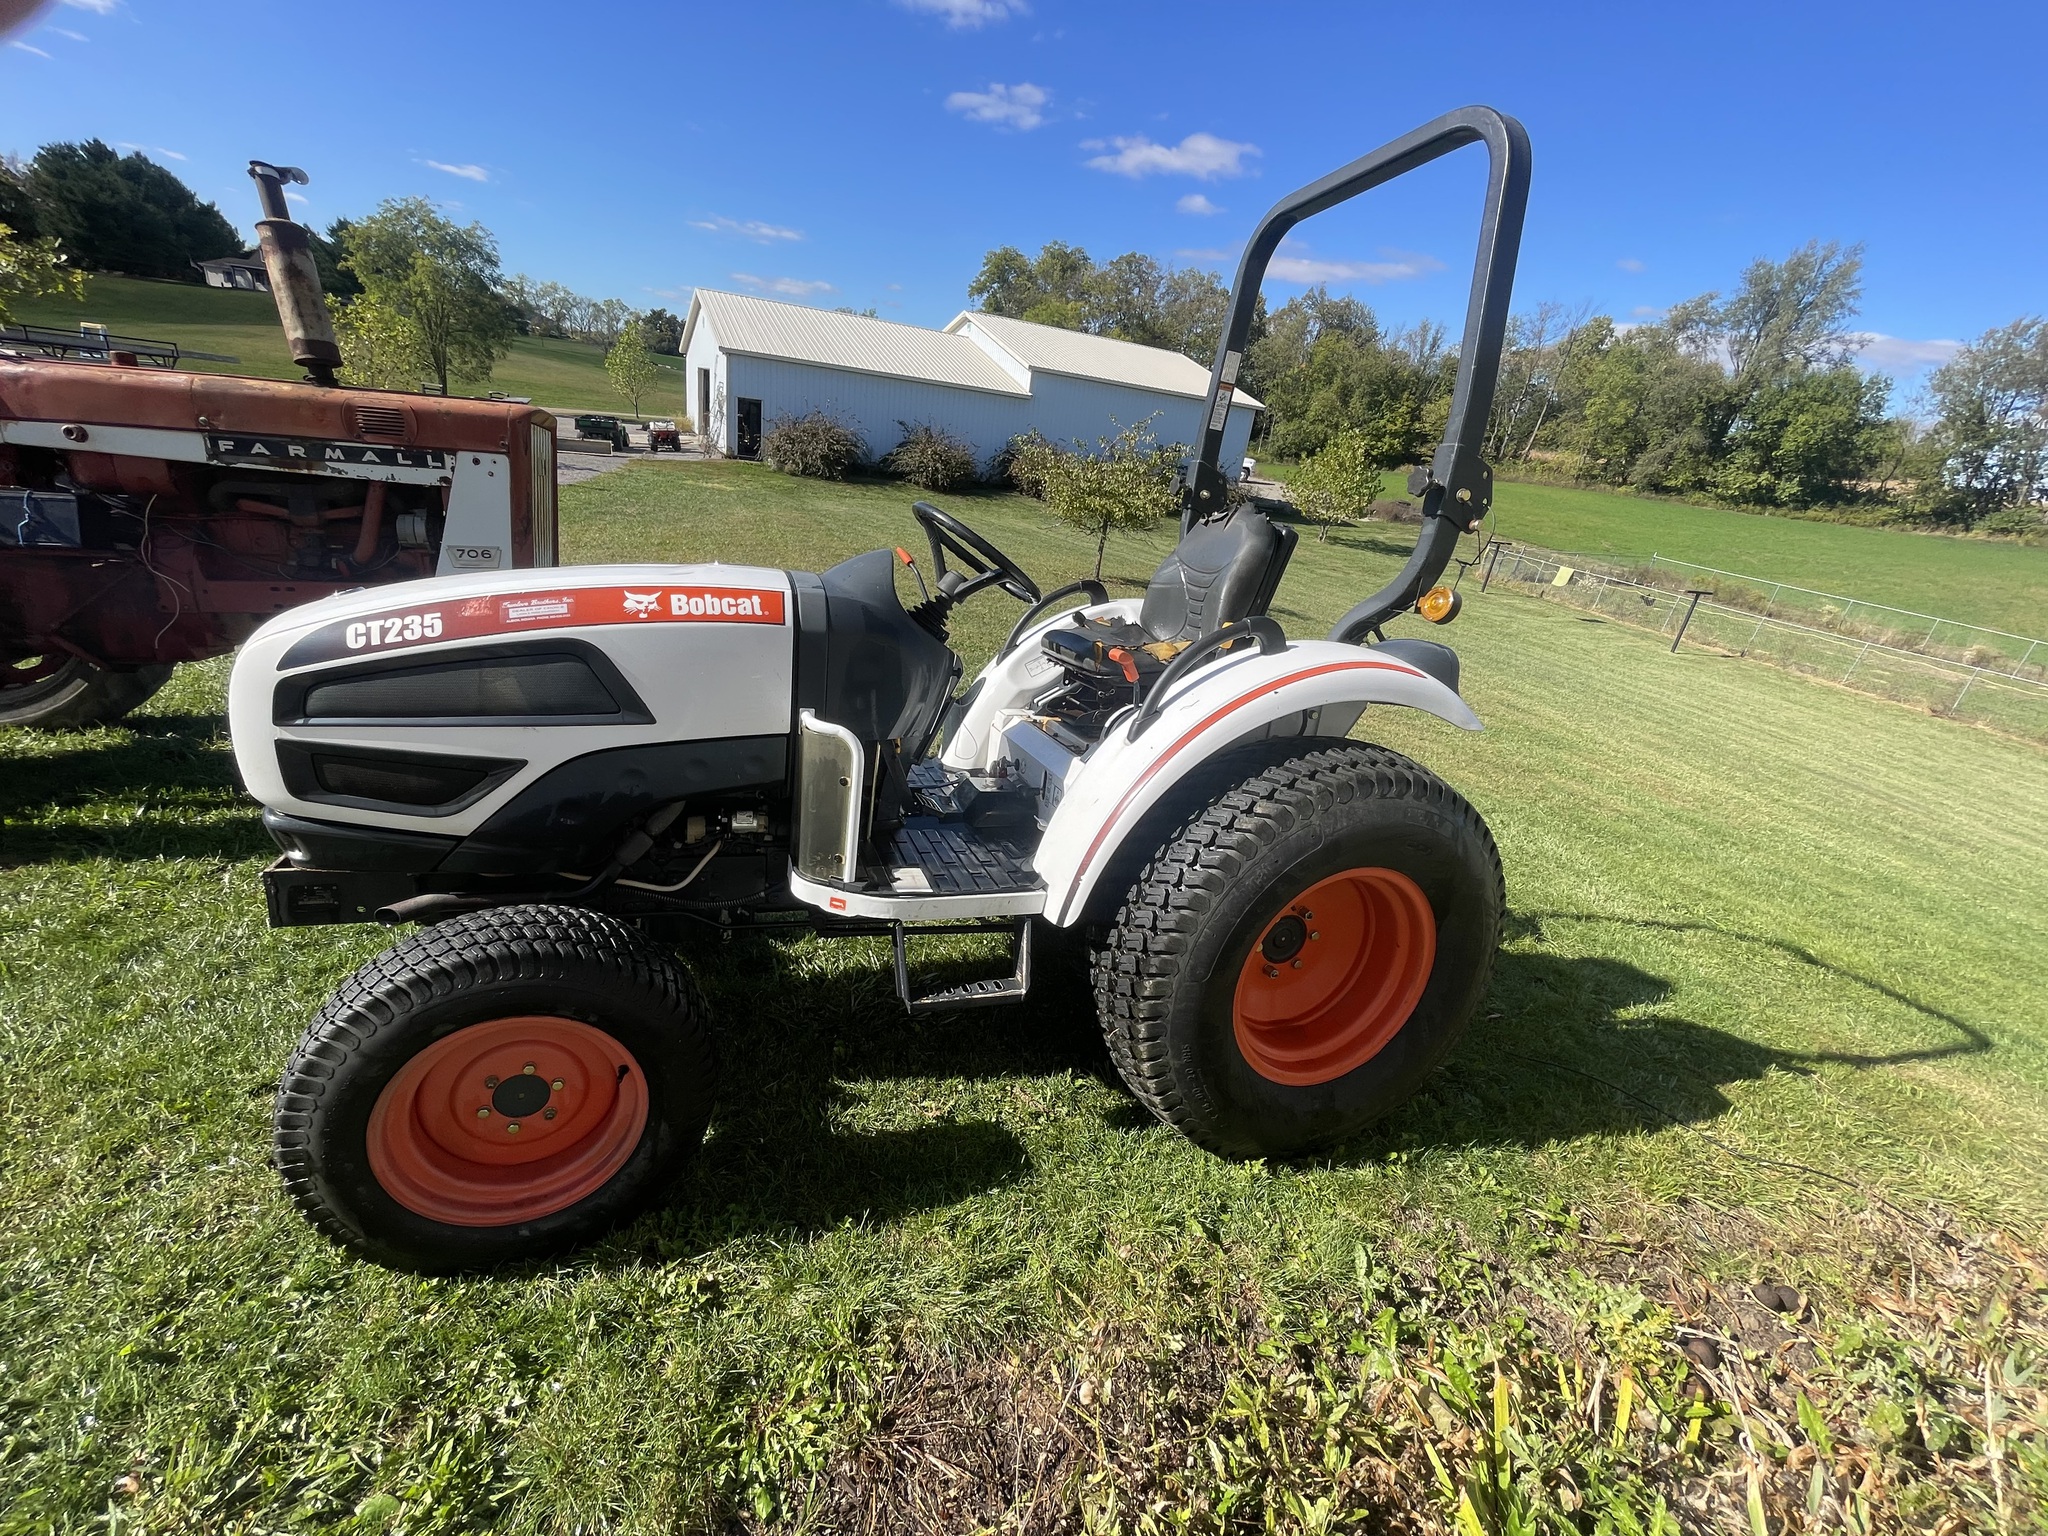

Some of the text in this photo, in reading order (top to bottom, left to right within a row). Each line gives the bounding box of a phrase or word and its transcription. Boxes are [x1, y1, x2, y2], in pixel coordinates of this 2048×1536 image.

[218, 440, 442, 467] FARMALL
[456, 549, 492, 559] 706
[670, 594, 763, 616] Bobcat
[346, 612, 443, 649] CT235
